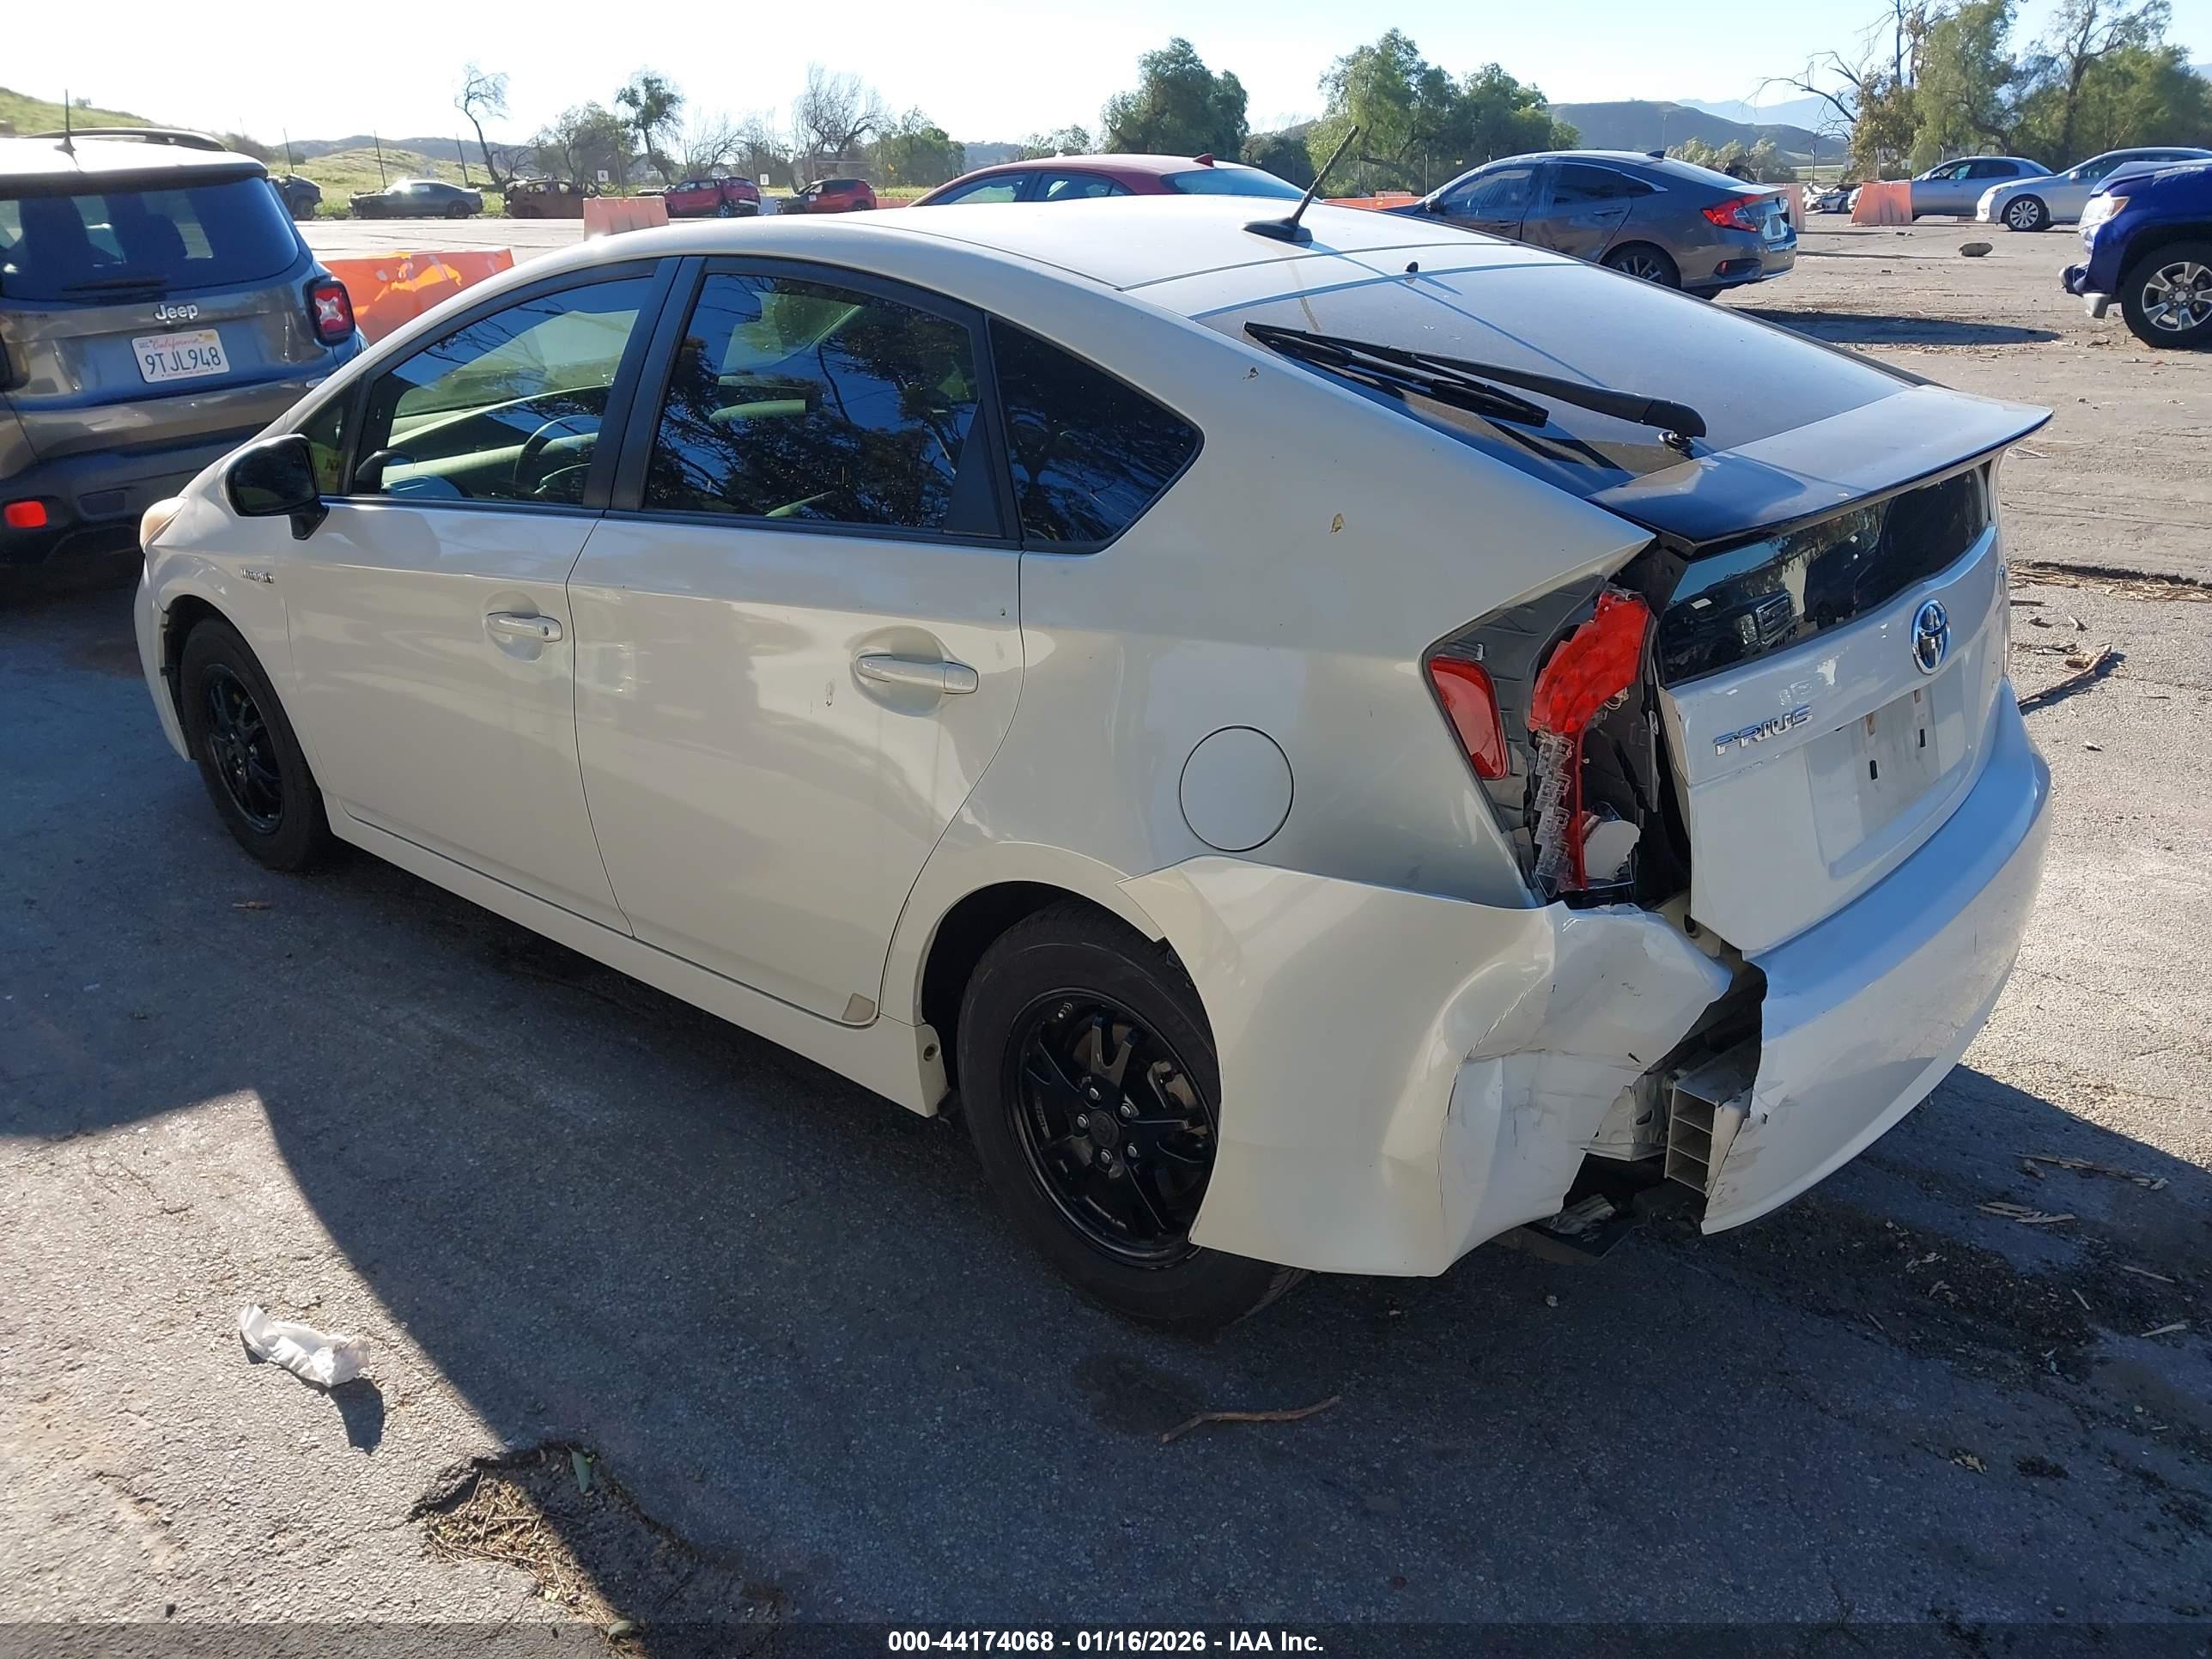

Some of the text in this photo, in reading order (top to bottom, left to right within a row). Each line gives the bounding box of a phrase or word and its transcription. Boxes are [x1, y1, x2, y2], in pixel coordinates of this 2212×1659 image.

[155, 304, 198, 319] Jeep
[145, 347, 221, 375] 9TJL948
[1714, 705, 1813, 756] PRIUS
